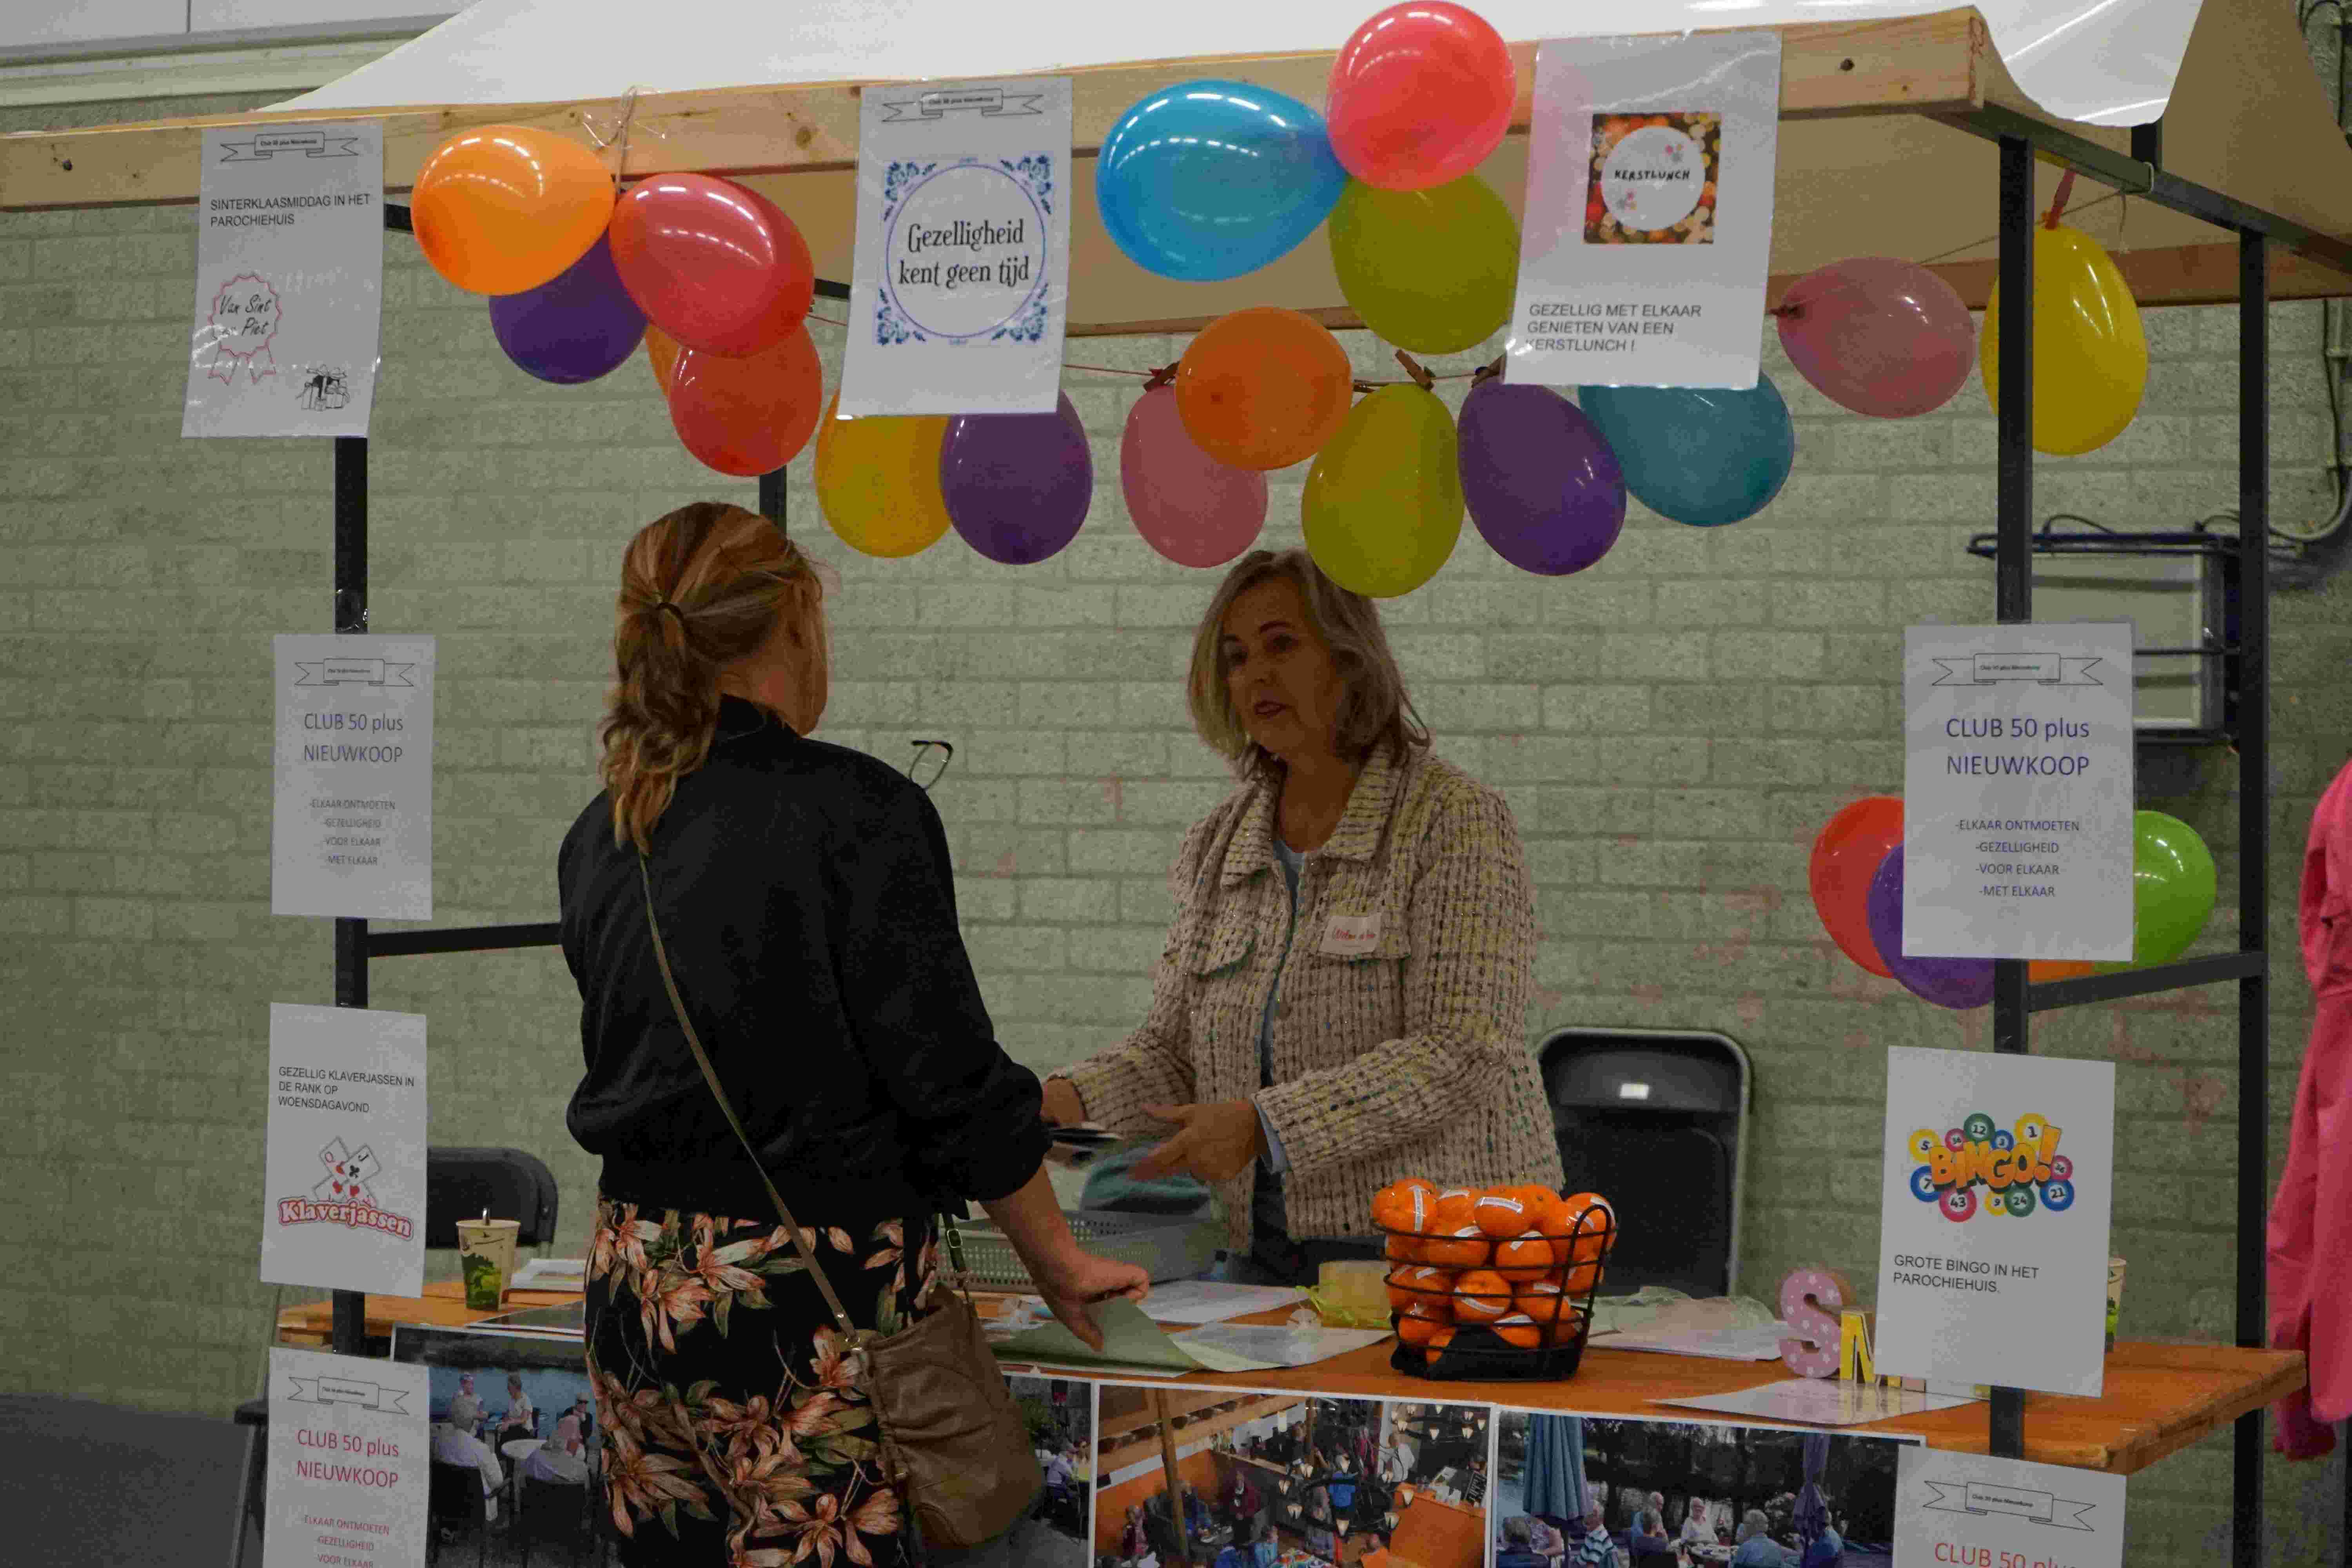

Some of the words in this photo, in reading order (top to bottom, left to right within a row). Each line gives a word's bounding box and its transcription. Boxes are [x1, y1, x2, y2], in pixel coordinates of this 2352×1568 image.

[1615, 169, 1690, 182] KERSTLUNCH
[210, 195, 331, 211] SINTERKLAASMIDDAG
[334, 194, 345, 206] IN
[348, 193, 371, 205] HET
[210, 213, 295, 227] PAROCHIEHUIS
[907, 218, 1024, 253] Gezelligheid
[898, 259, 940, 287] kent
[946, 263, 991, 289] geen
[998, 255, 1029, 288] tijd
[220, 295, 241, 315] Van
[245, 294, 272, 313] Sint
[1529, 304, 1602, 317] GEZELLIG
[1605, 304, 1639, 317] MET
[1641, 304, 1702, 317] ELKAAR
[241, 317, 269, 336] Piet
[1528, 321, 1604, 334] GENIETEN
[1607, 321, 1639, 334] VAN
[1643, 321, 1675, 335] EEN
[304, 713, 344, 730] CLUB
[348, 713, 367, 730] 50
[372, 713, 404, 734] plus
[1947, 718, 2003, 737] CLUB
[2011, 718, 2038, 737] 50
[2045, 717, 2090, 742] plus
[304, 744, 403, 762] NIEUWKOOP
[1947, 755, 2090, 776] NIEUWKOOP
[2005, 820, 2080, 831] ONTMOETEN
[351, 837, 381, 847] ELKAAR
[348, 856, 378, 866] ELKAAR
[2016, 864, 2060, 875] ELKAAR
[2012, 886, 2055, 897] ELKAAR
[279, 1066, 326, 1079] GEZELLIG
[328, 1070, 403, 1086] KLAVERJASSEN
[405, 1076, 415, 1087] IN
[279, 1081, 292, 1091] DE
[295, 1082, 321, 1094] RANK
[324, 1085, 338, 1094] OP
[278, 1096, 370, 1113] WOENSDAGAVOND
[1972, 1125, 1986, 1135] 12
[2027, 1125, 2038, 1138] 1
[1920, 1140, 1930, 1151] 5
[1929, 1124, 2062, 1192] BINGO!
[2013, 1196, 2027, 1205] 24
[2050, 1187, 2065, 1199] 21
[1950, 1197, 1966, 1208] 43
[279, 1198, 412, 1239] Klaverjassen
[1894, 1254, 1942, 1270] GROTE
[1946, 1259, 1990, 1274] BINGO
[1995, 1263, 2007, 1276] IN
[2012, 1265, 2040, 1279] HET
[1894, 1272, 2000, 1293] PAROCHIEHUIS.
[298, 1429, 338, 1449] CLUB
[343, 1434, 362, 1452] 50
[367, 1437, 399, 1457] plus
[297, 1459, 399, 1488] NIEUWKOOP
[1935, 1543, 1991, 1567] CLUB
